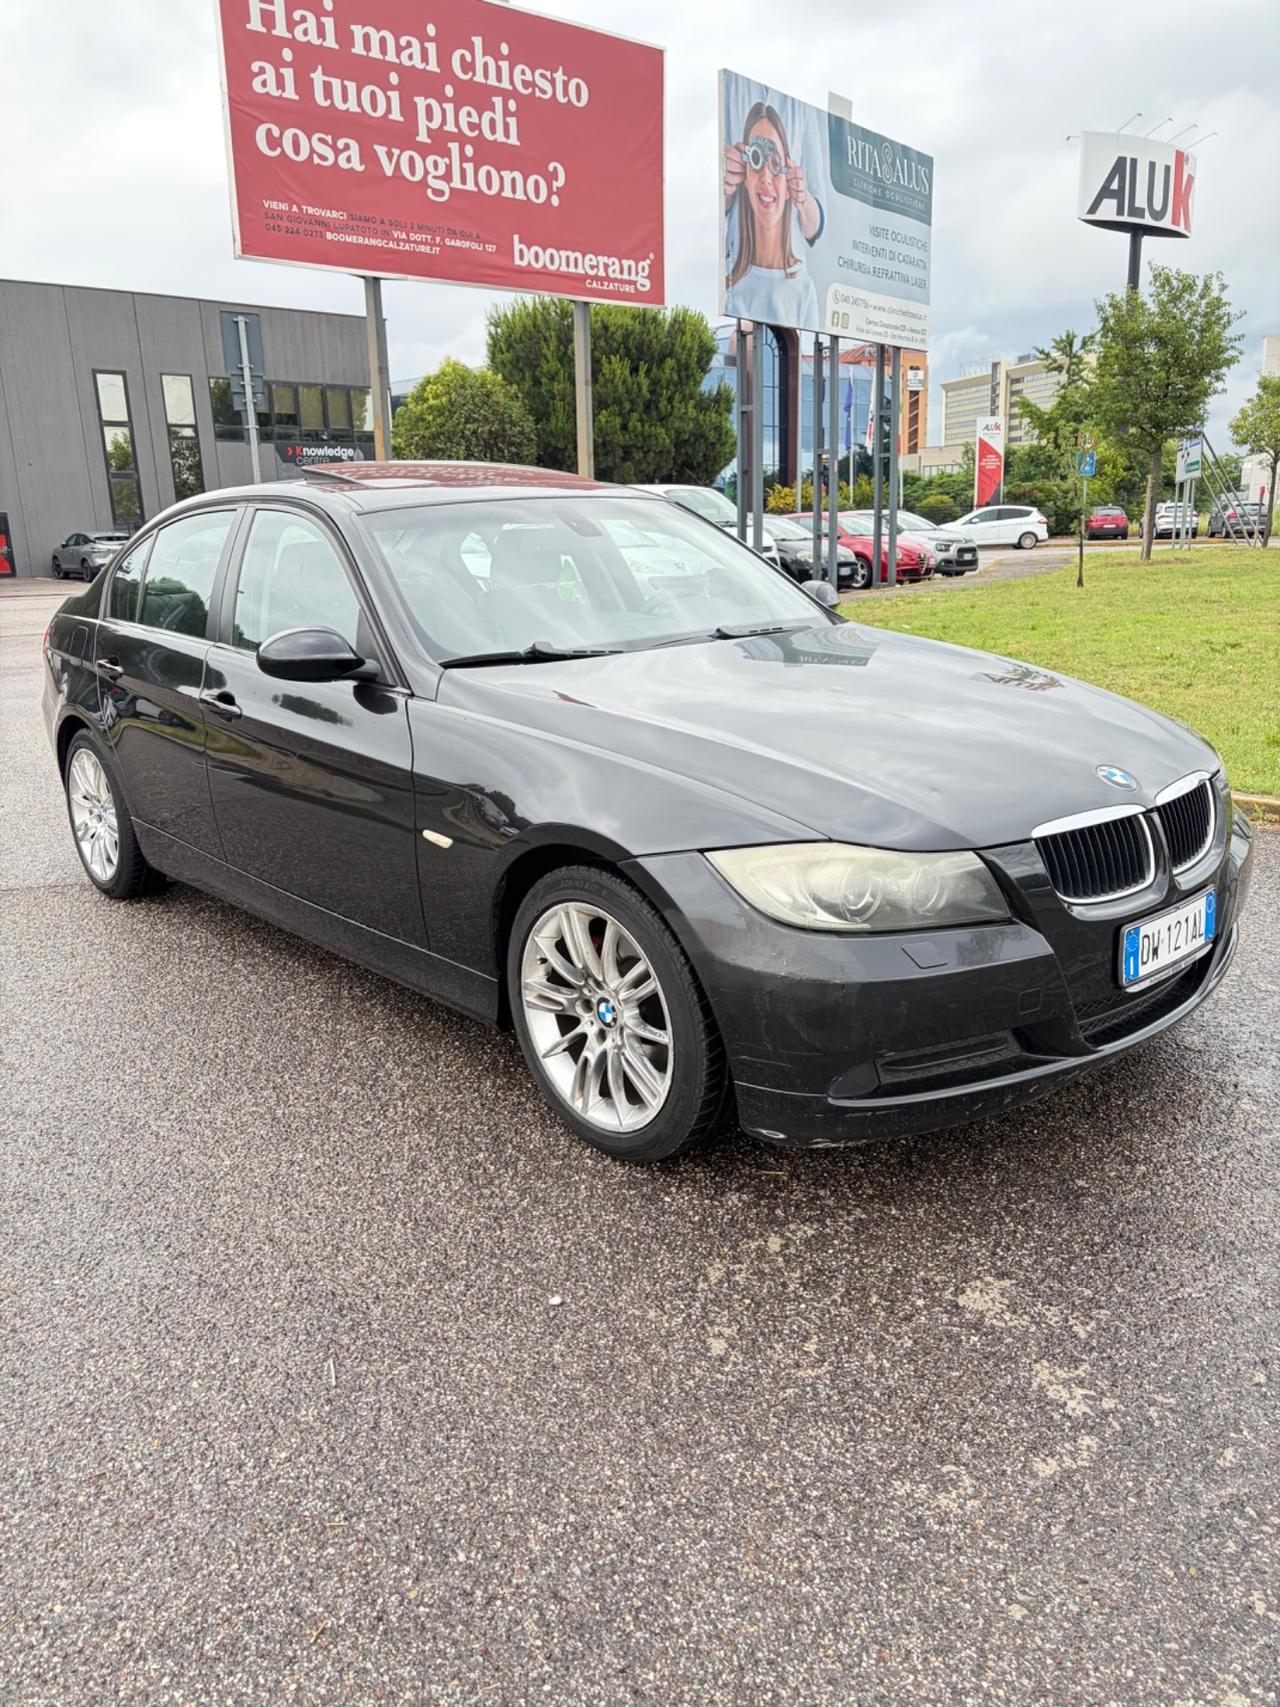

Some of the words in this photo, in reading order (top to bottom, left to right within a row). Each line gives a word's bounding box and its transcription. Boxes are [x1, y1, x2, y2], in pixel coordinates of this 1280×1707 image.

[246, 0, 340, 50] Hai
[350, 23, 441, 73] mai
[451, 36, 589, 108] chiesto
[250, 47, 300, 101] ai
[309, 65, 405, 122] tuoi
[413, 84, 521, 146] piedi
[255, 122, 365, 172] cosa
[373, 141, 567, 207] vogliono?
[262, 199, 289, 212] VIENI
[291, 204, 299, 213] A
[301, 205, 348, 220] TROVARCI
[349, 213, 377, 224] SIAMO
[388, 219, 407, 229] SOLI
[416, 223, 445, 233] MINUTI
[447, 227, 458, 236] DA
[459, 230, 474, 238] QUI
[264, 211, 283, 221] SAN
[287, 215, 330, 229] GIOVANNI
[333, 222, 378, 235] LUPATOTO
[392, 230, 407, 240] VIA
[409, 232, 434, 244] DOTT.
[435, 236, 443, 245] F.
[445, 238, 483, 251] GAROFOLI
[485, 244, 497, 253] 127
[265, 223, 282, 233] 045
[285, 226, 300, 235] 224
[325, 231, 441, 255] BOOMERANGCALZATURE.IT
[852, 238, 887, 260] INTERVENTI
[889, 250, 897, 261] DI
[869, 224, 889, 241] VISITE
[891, 230, 928, 253] OCULISTICHE
[513, 233, 651, 291] boomerang
[837, 255, 872, 275] CHIRURGIA
[911, 276, 927, 290] LASER
[585, 279, 636, 293] CALZATURE
[295, 445, 355, 462] Knowledge
[296, 456, 330, 466] centre
